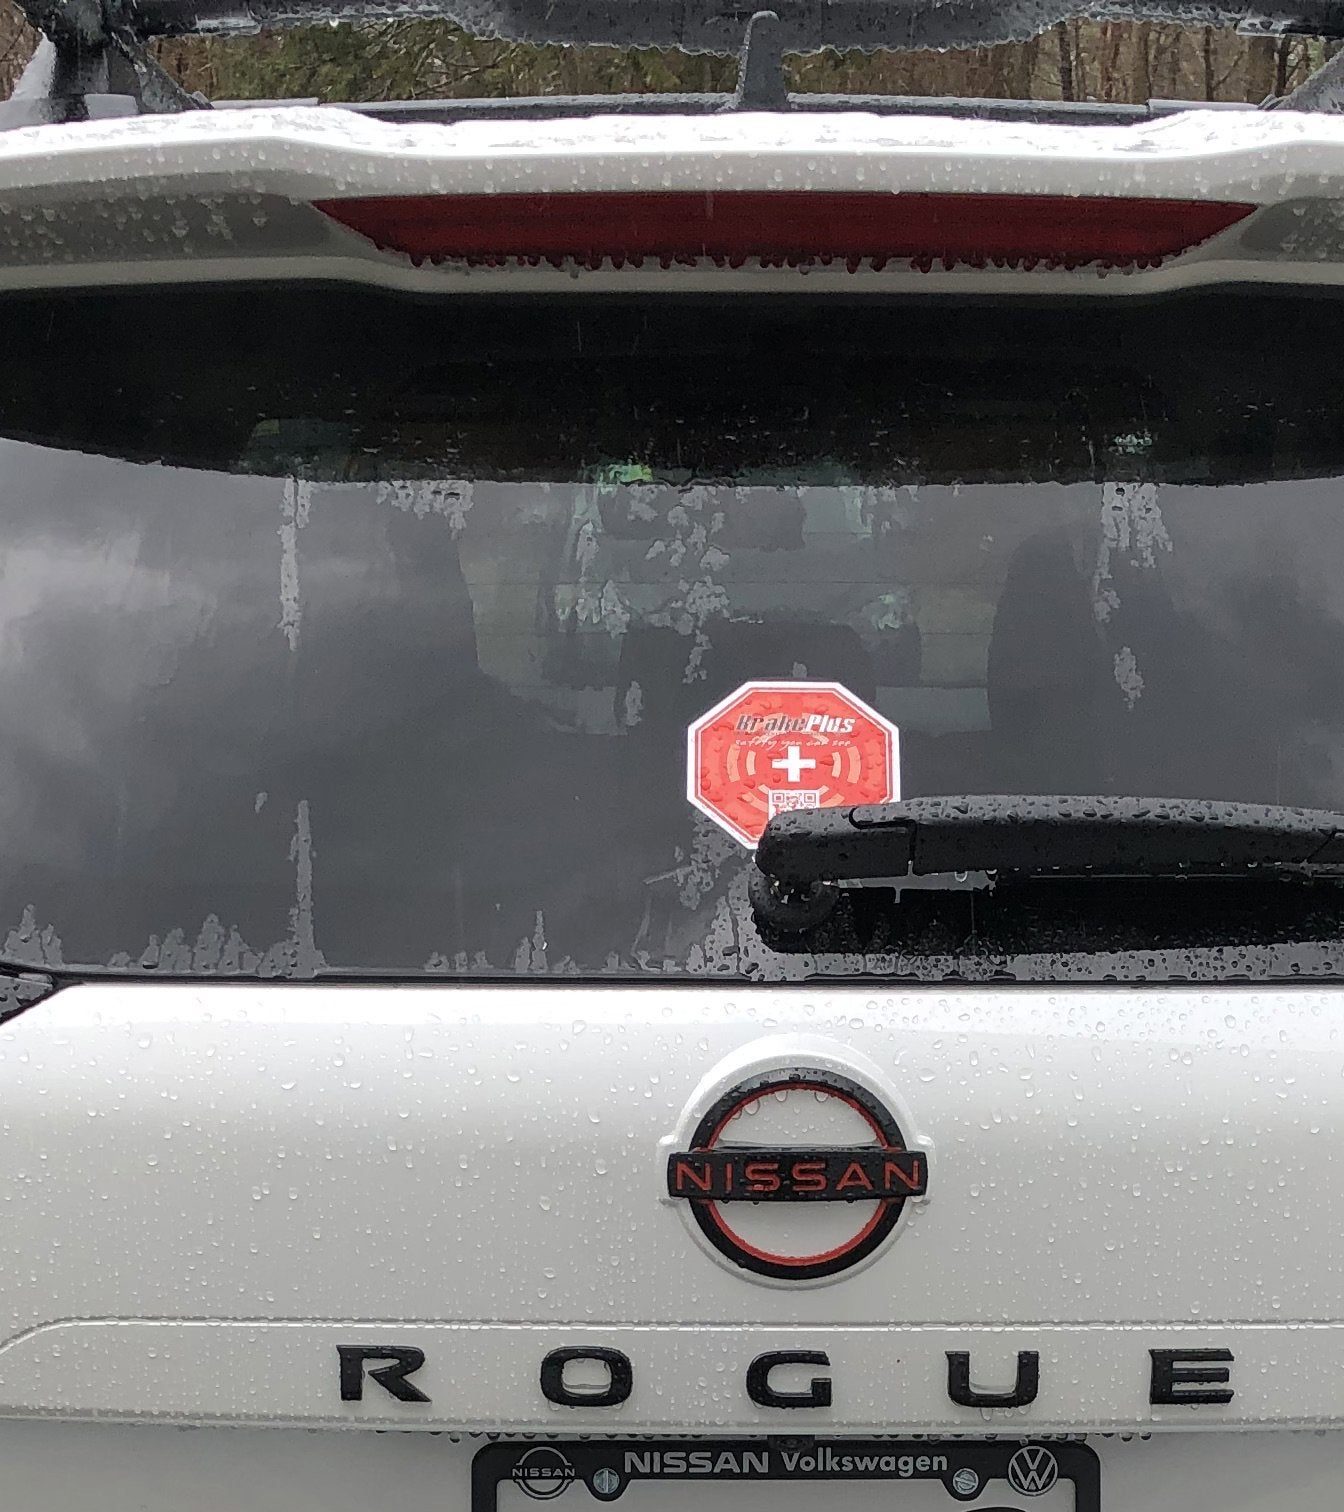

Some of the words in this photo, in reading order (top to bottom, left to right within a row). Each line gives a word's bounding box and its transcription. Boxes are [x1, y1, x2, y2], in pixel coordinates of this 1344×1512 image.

[675, 1160, 921, 1191] NISSAN
[335, 1344, 1236, 1407] ROGUE
[512, 1467, 575, 1477] NISSAN
[624, 1451, 769, 1474] NISSAN
[780, 1446, 948, 1477] Volkswagen
